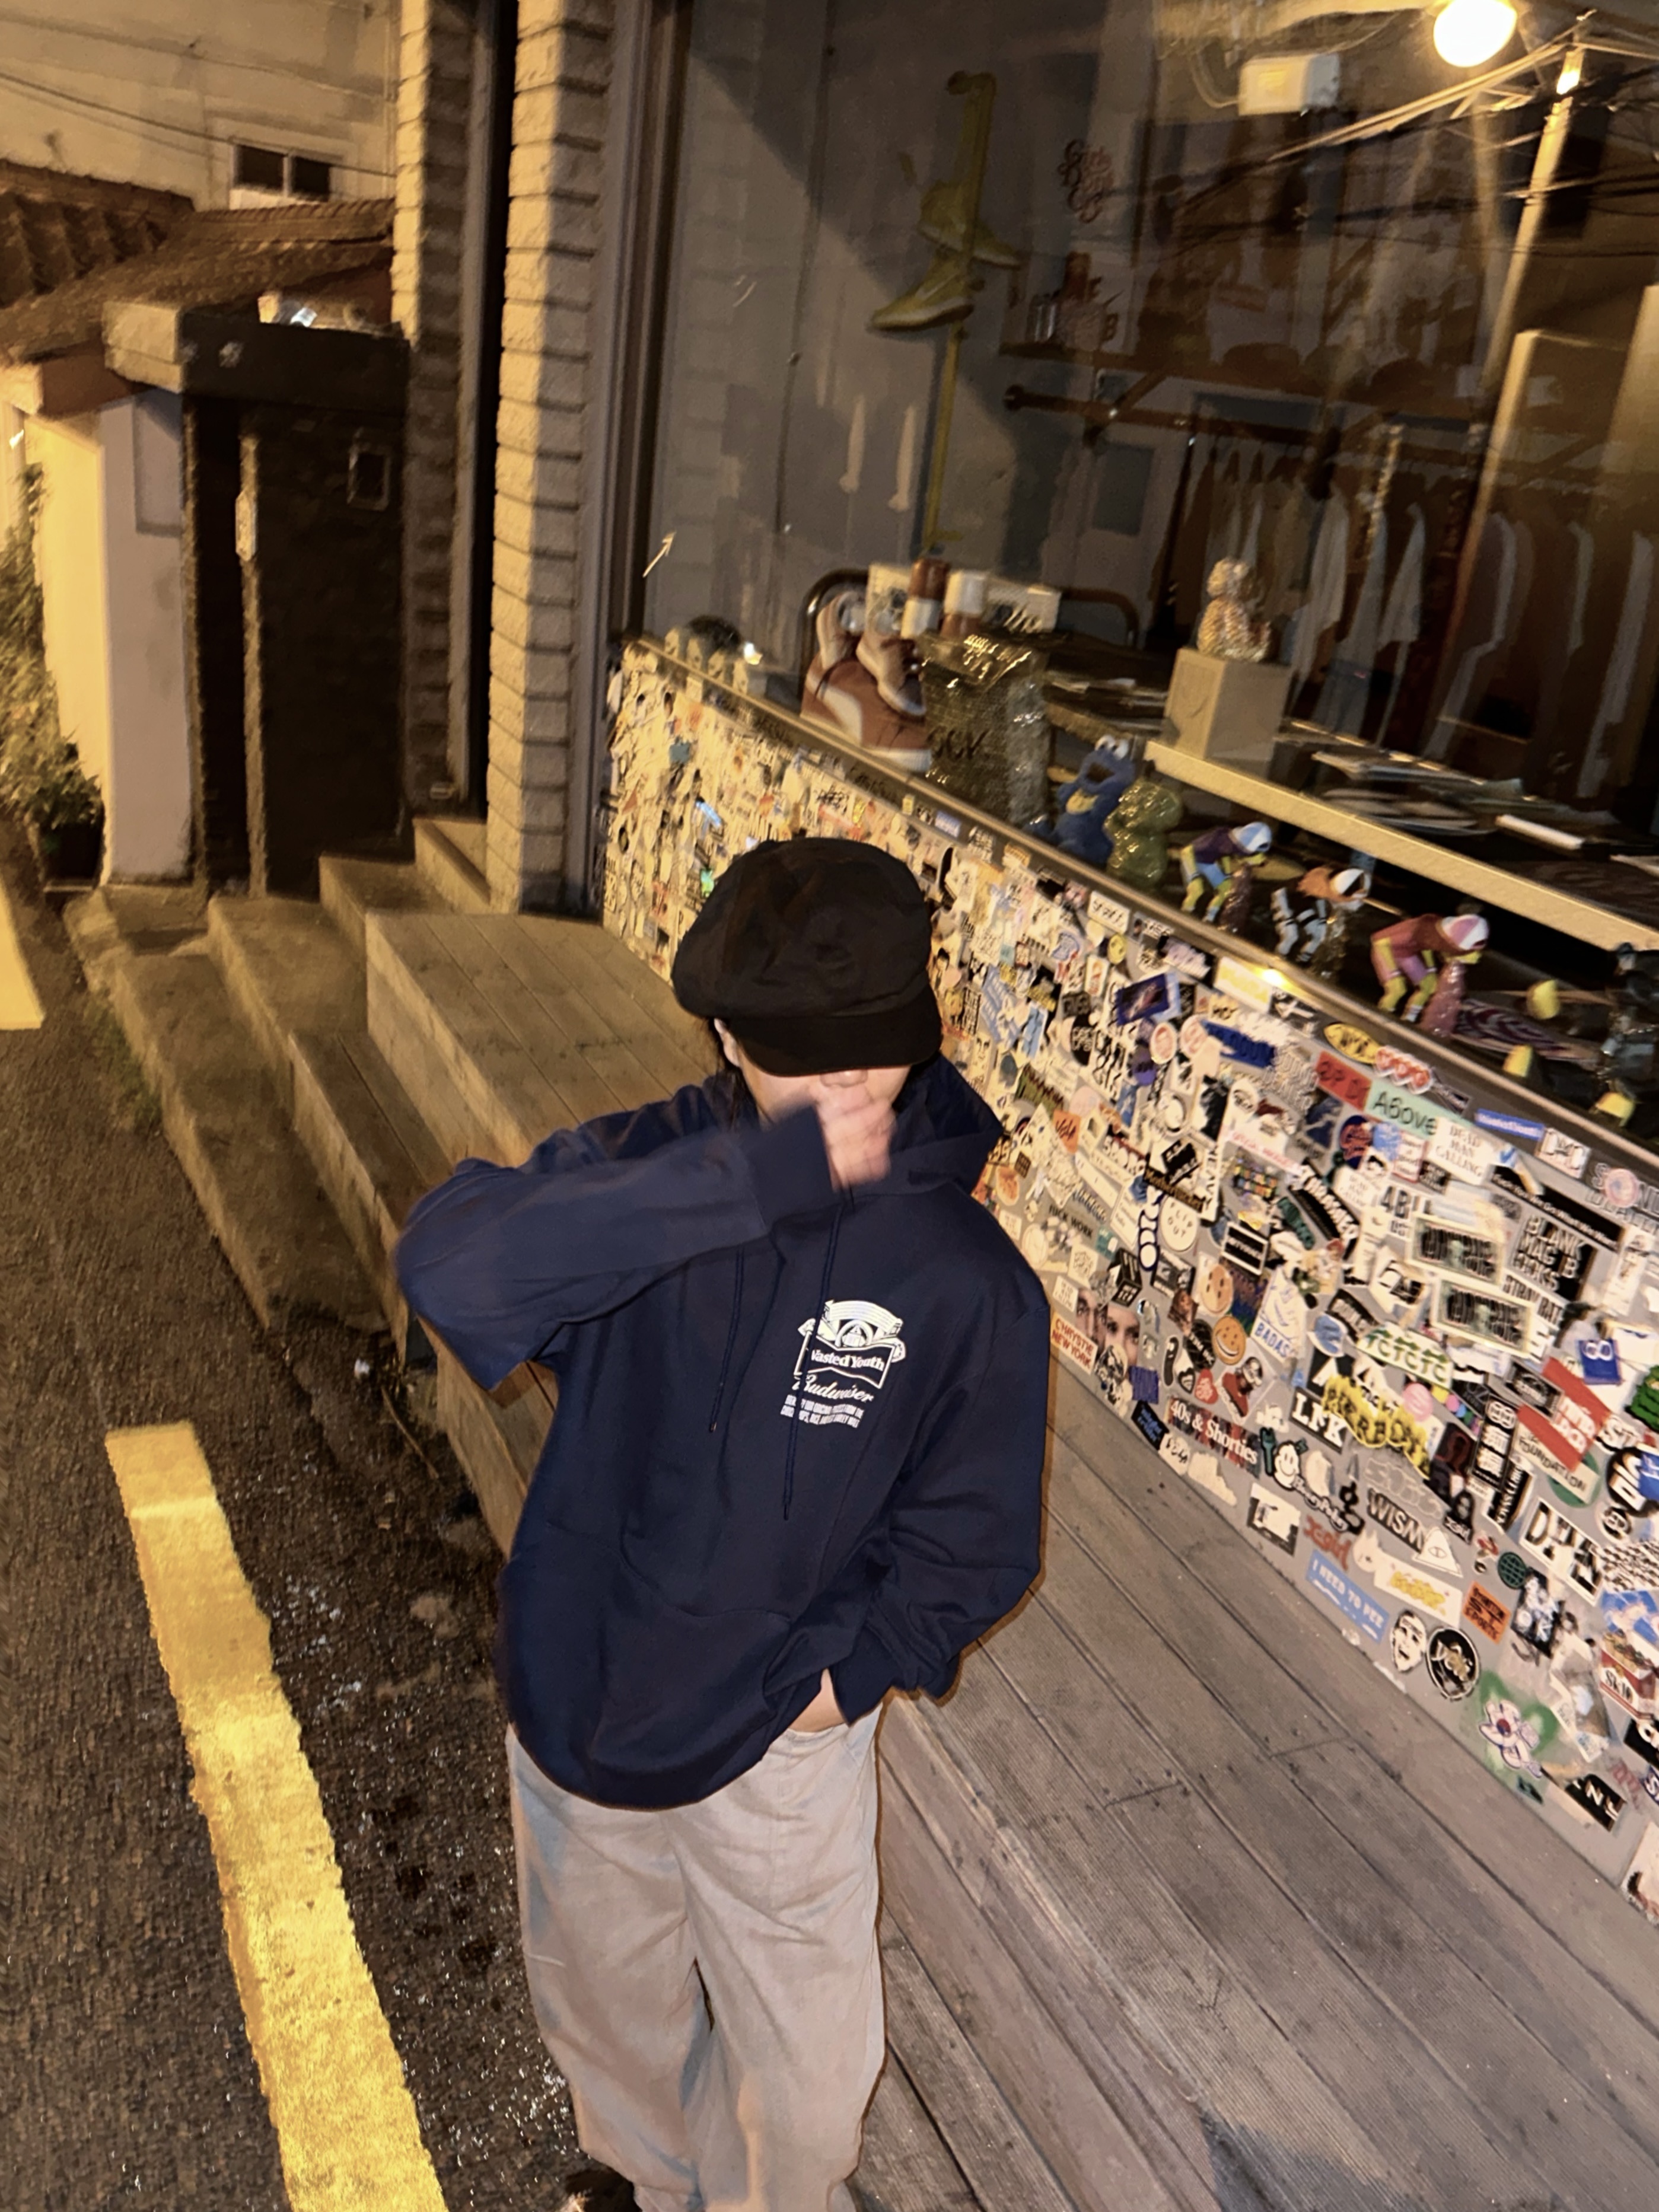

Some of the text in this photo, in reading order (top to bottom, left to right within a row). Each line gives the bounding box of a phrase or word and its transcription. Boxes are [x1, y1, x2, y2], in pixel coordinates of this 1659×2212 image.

[1052, 1329, 1093, 1369] NEW YORK
[1055, 1319, 1094, 1357] CHRYSTIE
[851, 1355, 885, 1372] Youth
[792, 1373, 875, 1403] Budweiser
[1170, 1399, 1191, 1424] 40s
[1192, 1414, 1205, 1433] &
[1204, 1419, 1259, 1465] Shorties
[1319, 1563, 1346, 1595] NEED
[1347, 1587, 1362, 1609] TO
[1362, 1605, 1384, 1630] PEE
